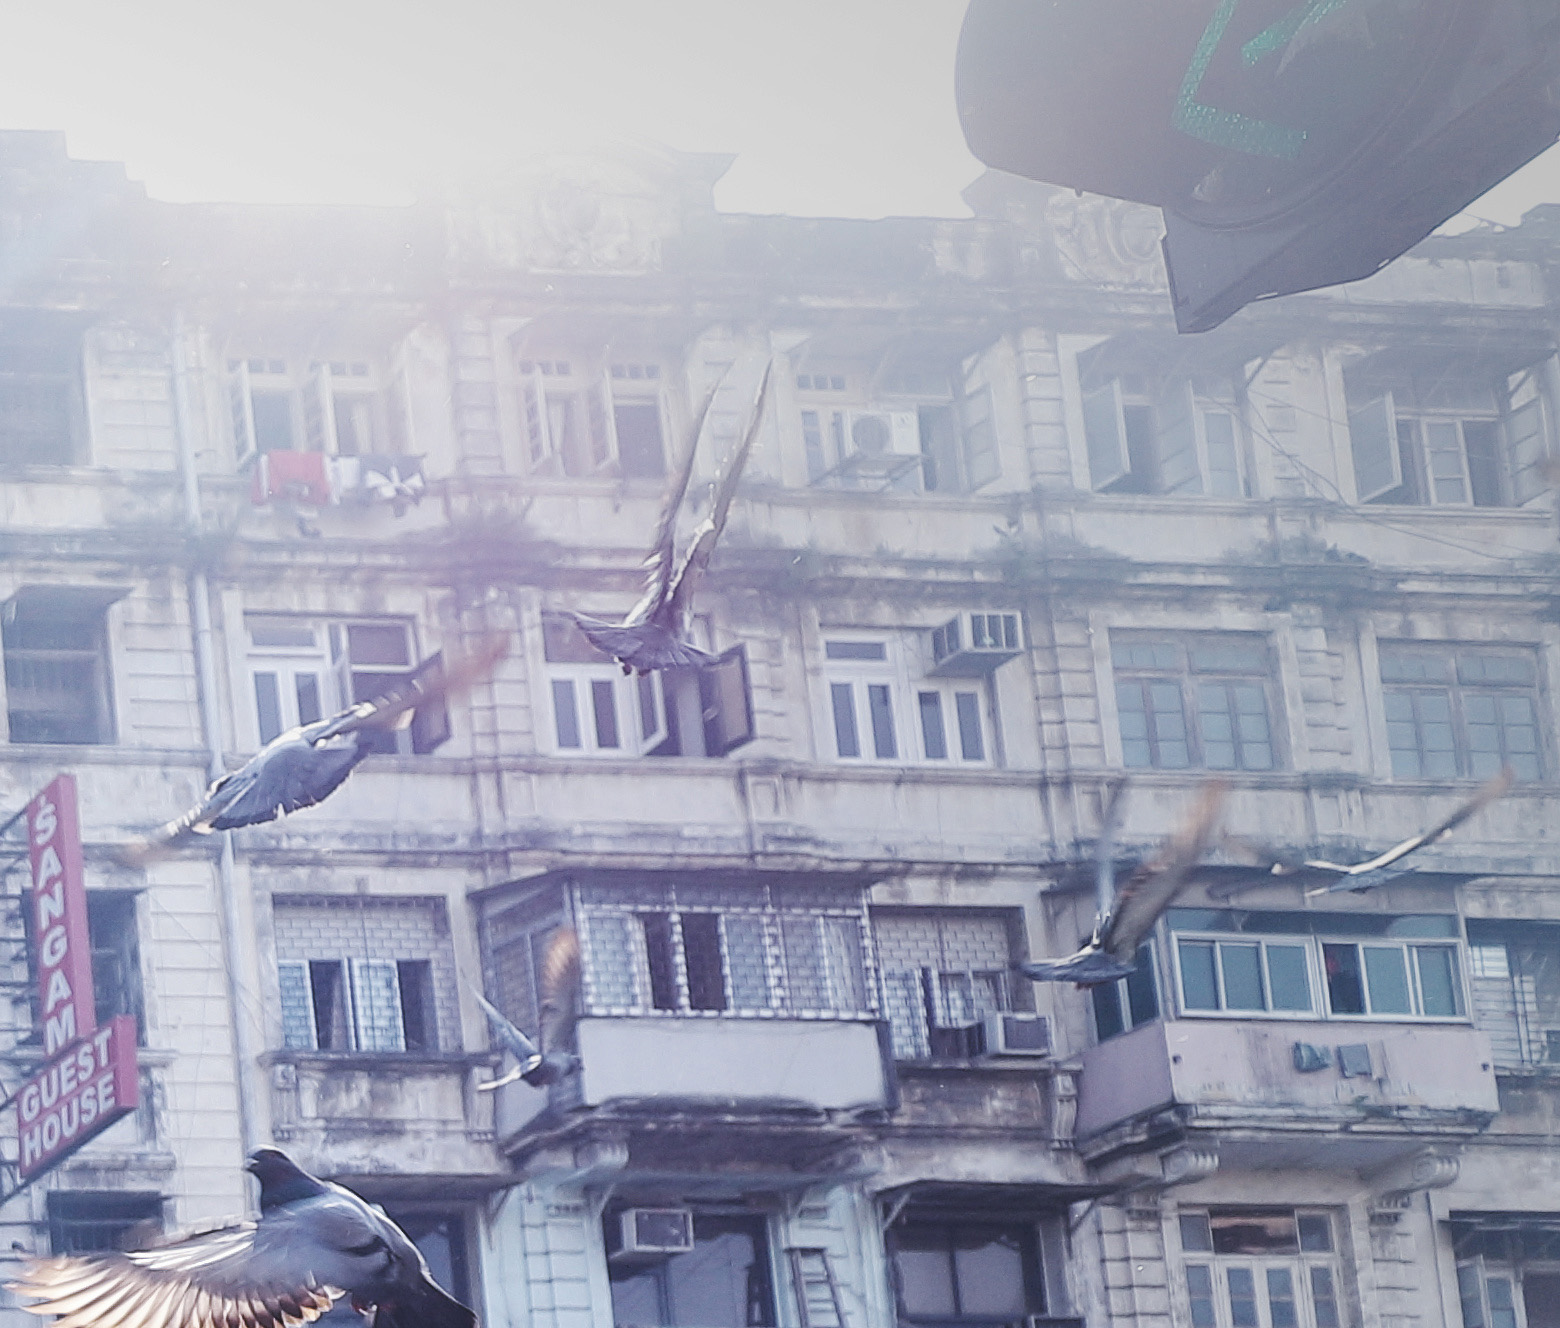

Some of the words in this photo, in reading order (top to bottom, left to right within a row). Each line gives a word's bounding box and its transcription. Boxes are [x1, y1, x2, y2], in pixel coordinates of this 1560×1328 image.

[35, 802, 77, 1056] SANGAM
[21, 1026, 113, 1124] GUEST
[24, 1069, 116, 1168] HOUSE
